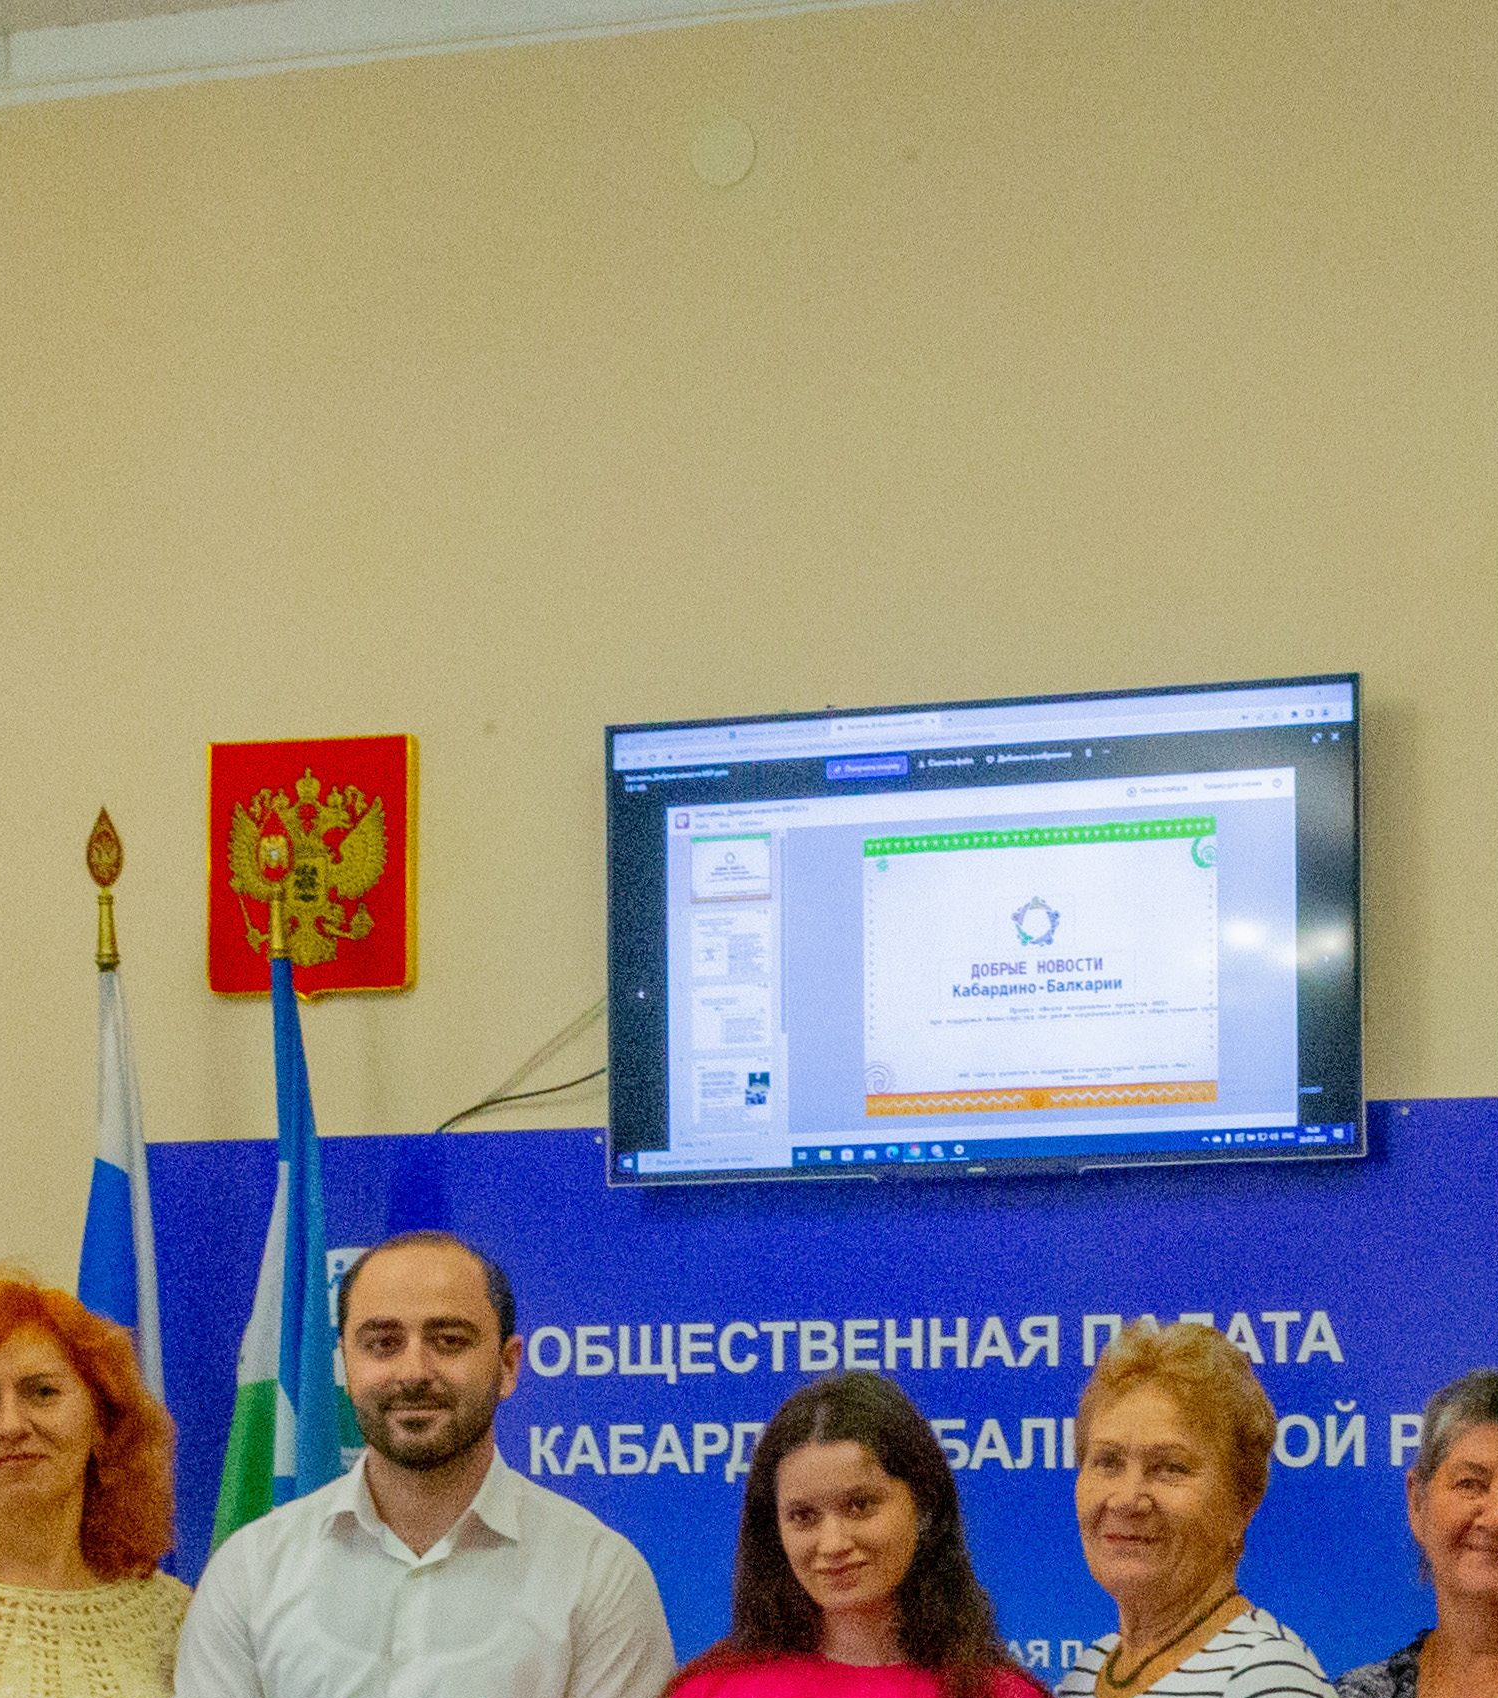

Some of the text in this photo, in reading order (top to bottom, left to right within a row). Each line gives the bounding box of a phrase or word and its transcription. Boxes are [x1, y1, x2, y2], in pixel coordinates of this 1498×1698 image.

[970, 957, 1103, 980] ДОБРЫЕ НОВОСТИ
[951, 978, 1123, 999] Кабардино-Балкарии
[527, 1310, 1345, 1385] ОБЩЕСТВЕННАЯ ПАТА
